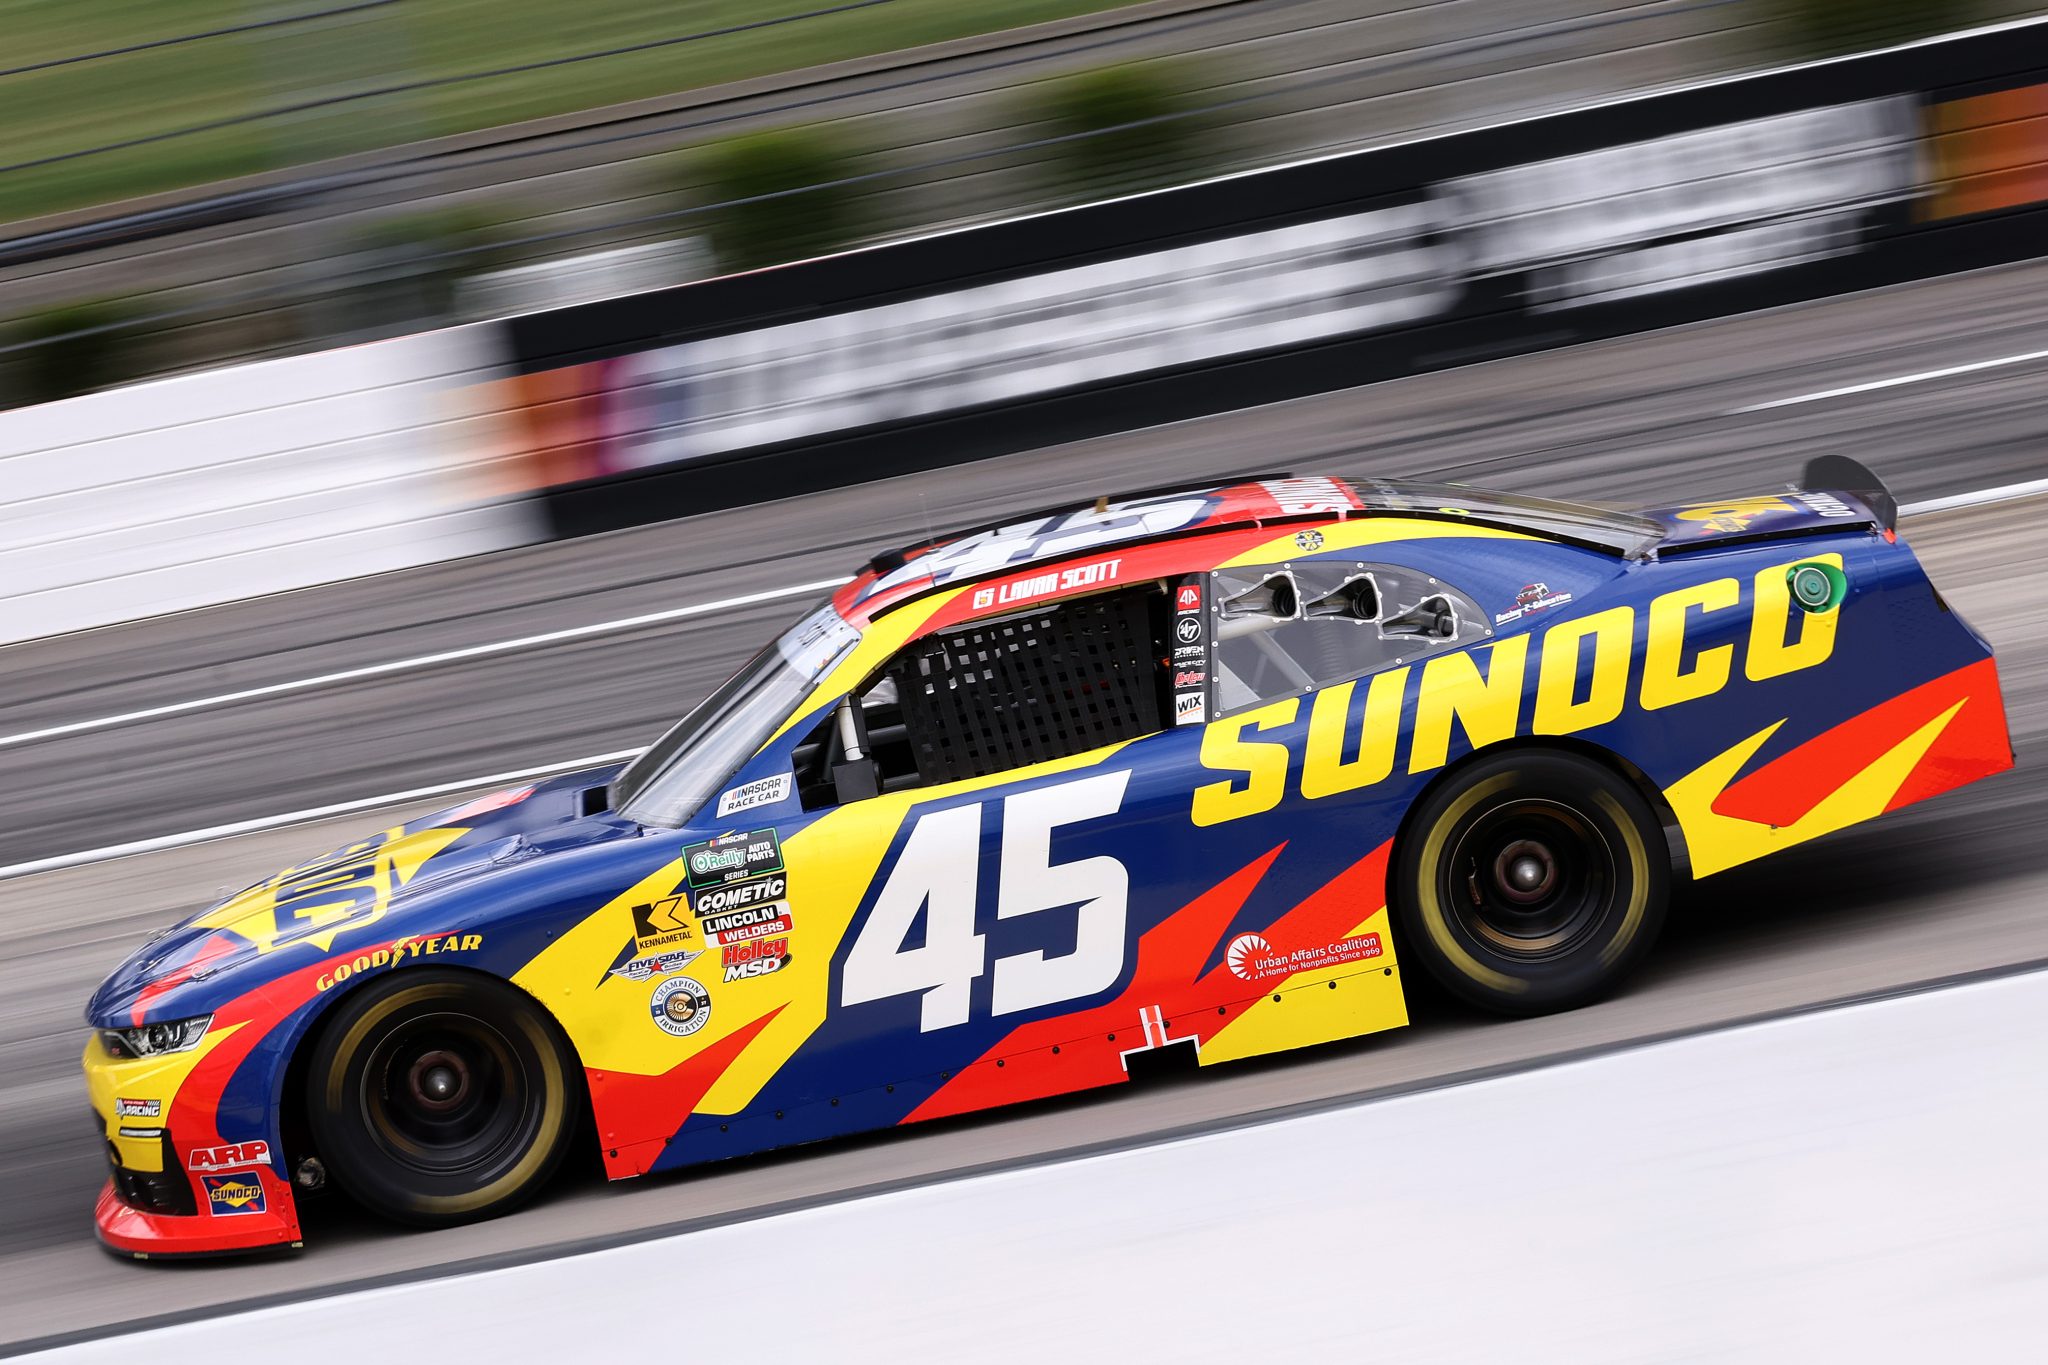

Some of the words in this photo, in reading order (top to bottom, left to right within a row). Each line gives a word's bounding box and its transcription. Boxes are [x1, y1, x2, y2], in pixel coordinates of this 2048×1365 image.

[998, 572, 1058, 604] LAVAR
[1060, 559, 1122, 590] SCOTT
[1190, 552, 1843, 827] SUNOCO
[1178, 695, 1202, 713] WIX
[741, 778, 781, 797] NASCAR
[727, 796, 755, 811] RACE
[758, 790, 780, 802] CAR
[718, 833, 748, 845] NASCAR
[694, 849, 745, 873] O'Reilly
[748, 841, 771, 853] AUTO
[747, 849, 775, 862] PARTS
[724, 870, 749, 881] SERIES
[697, 879, 785, 912] COMETIC
[841, 768, 1133, 1034] 45
[704, 904, 738, 915] GASKET
[706, 908, 775, 933] LINCOLN
[638, 931, 692, 949] KENNAMETAL
[724, 921, 785, 942] WELDERS
[628, 959, 654, 972] FIVE
[658, 951, 685, 962] STAR
[723, 938, 788, 966] Holley
[1255, 956, 1288, 970] Urban
[1291, 948, 1326, 962] Affairs
[1328, 937, 1377, 954] Coalition
[1266, 966, 1288, 976] Home
[1289, 963, 1299, 972] for
[1300, 956, 1339, 969] Nonprofits
[1341, 952, 1360, 961] Since
[1362, 947, 1380, 957] 1969
[724, 958, 781, 983] MSD
[656, 980, 701, 1001] CHAMPION
[659, 1009, 707, 1033] IRRIGATION
[125, 1106, 160, 1116] RACING
[191, 1141, 268, 1166] ARP
[213, 1187, 260, 1201] SUNOCO
